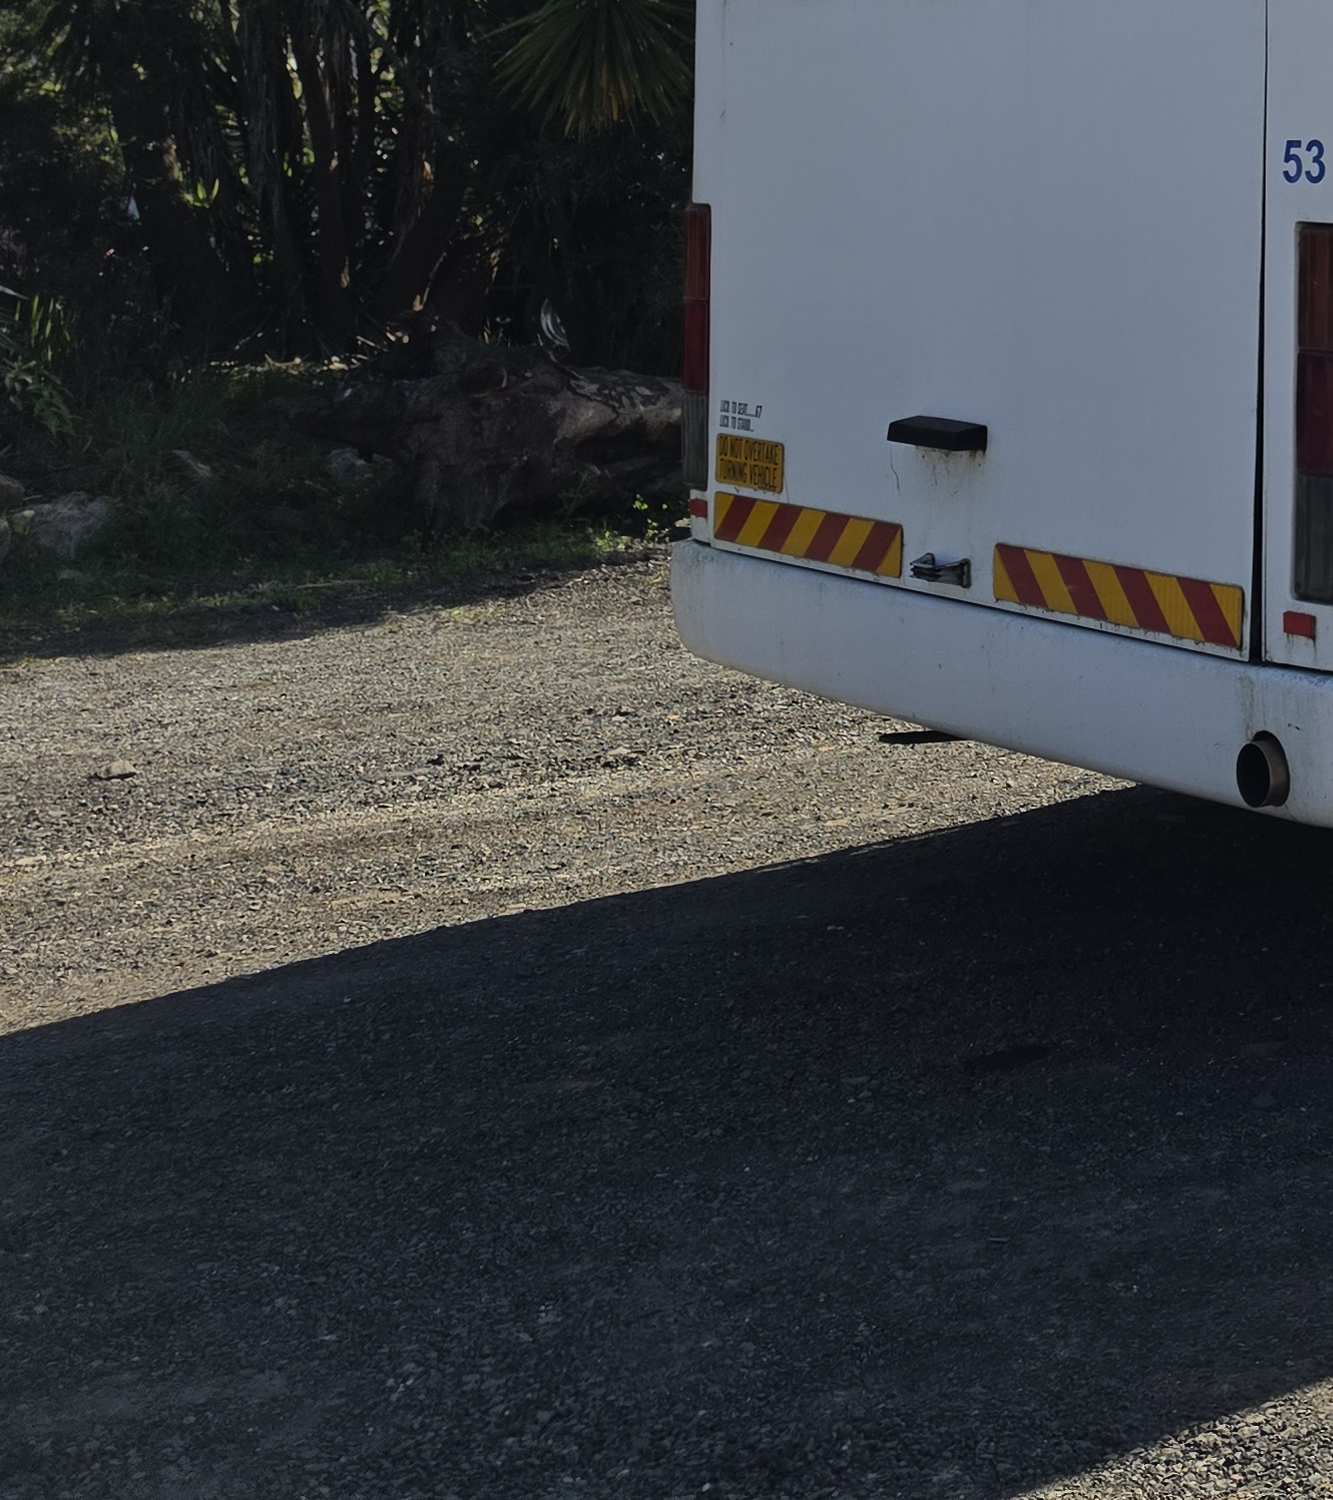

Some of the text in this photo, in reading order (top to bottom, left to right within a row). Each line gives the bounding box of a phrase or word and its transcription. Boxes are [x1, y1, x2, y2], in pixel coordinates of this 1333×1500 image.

[1282, 139, 1326, 184] 53
[719, 435, 779, 466] DO NOT OVERTAKE
[719, 458, 778, 489] TURNING VEHICLE
